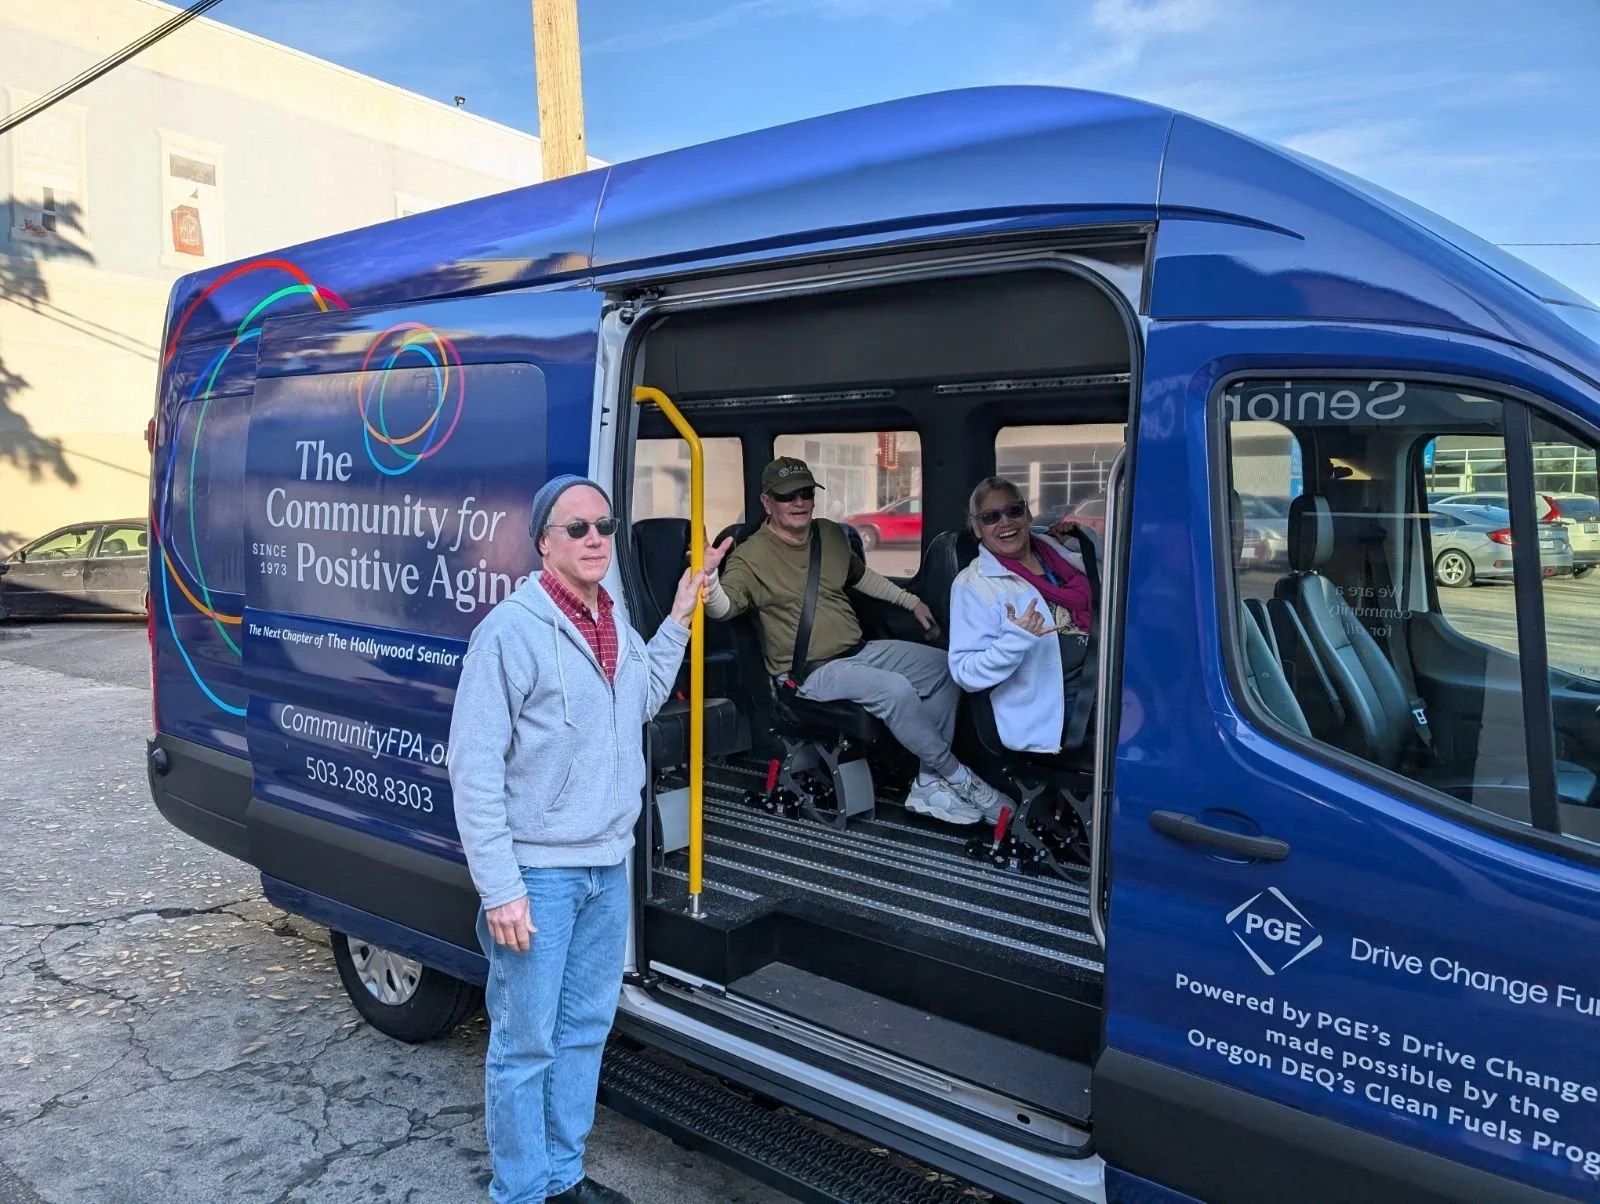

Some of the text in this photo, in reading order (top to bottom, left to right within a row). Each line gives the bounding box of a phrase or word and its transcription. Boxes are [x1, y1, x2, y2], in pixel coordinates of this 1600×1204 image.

[296, 440, 353, 481] The
[266, 487, 506, 551] Community for
[252, 543, 287, 558] SINCE
[260, 561, 287, 576] 1973
[297, 542, 420, 595] Positive
[249, 624, 262, 636] The
[263, 626, 281, 639] Next
[282, 629, 313, 645] Chapter
[314, 634, 324, 648] of
[327, 633, 347, 650] The
[350, 636, 415, 660] Hollywood
[417, 646, 460, 666] Senior
[306, 756, 434, 812] 503.288.8303
[1245, 913, 1302, 946] PGE
[1351, 937, 1423, 975] Drive
[1430, 957, 1548, 1004] Change
[1175, 973, 1598, 1103] Powered by PGE's Drive Change
[1187, 1028, 1600, 1175] Oregon DEQ's Clean Fuels Prog
[1266, 1026, 1560, 1124] made possible by the
